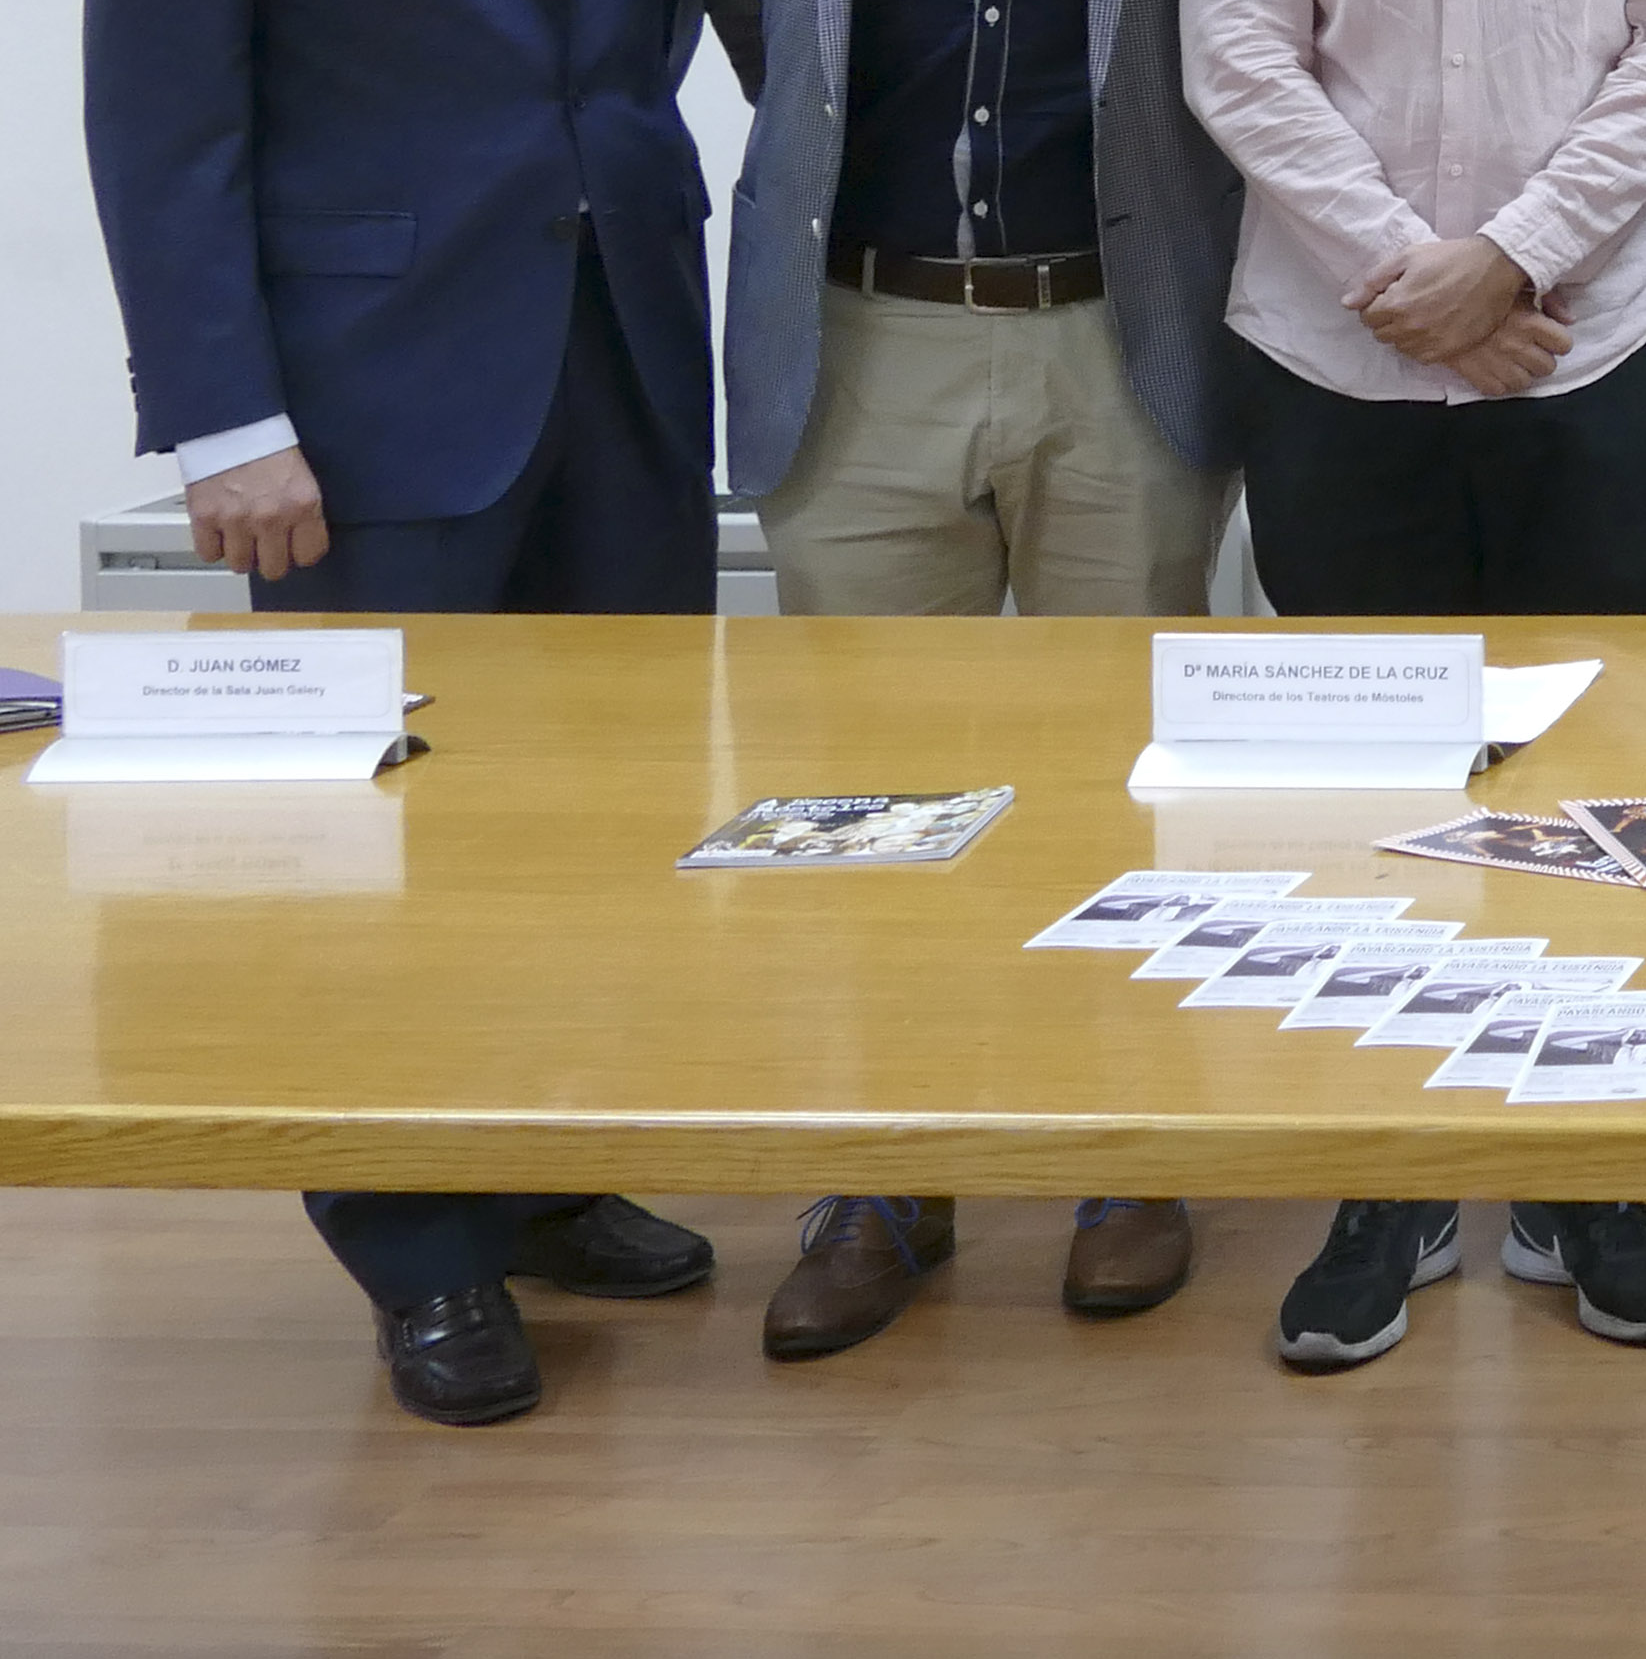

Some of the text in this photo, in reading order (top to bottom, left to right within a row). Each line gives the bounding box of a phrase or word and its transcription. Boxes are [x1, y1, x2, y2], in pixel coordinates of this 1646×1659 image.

[167, 656, 302, 673] D. JUAN GÓMEZ
[1206, 661, 1260, 679] MARÍA
[1265, 661, 1343, 680] SÁNCHEZ
[1349, 665, 1371, 679] DE
[1376, 666, 1399, 680] LA
[1402, 666, 1449, 681] CRUZ
[143, 685, 190, 696] Director
[194, 685, 208, 696] de
[211, 685, 223, 696] la
[255, 685, 284, 696] Juan
[1212, 691, 1424, 703] Directora de los Teatros de Móstoles
